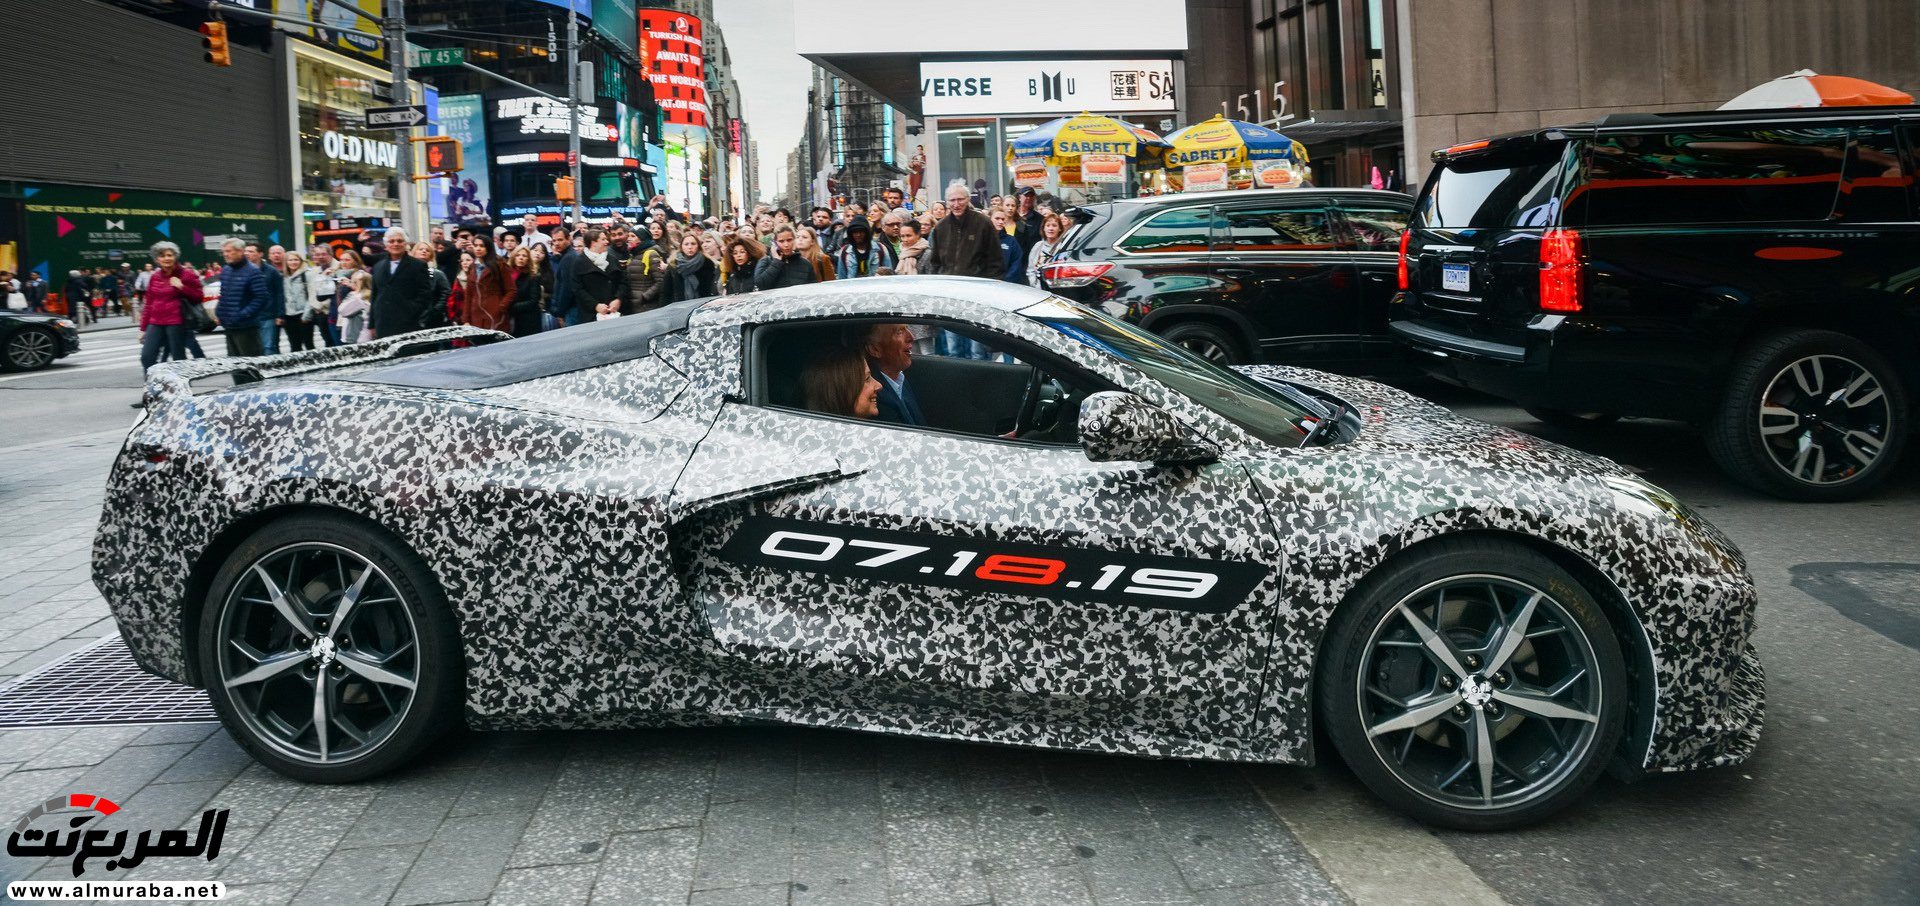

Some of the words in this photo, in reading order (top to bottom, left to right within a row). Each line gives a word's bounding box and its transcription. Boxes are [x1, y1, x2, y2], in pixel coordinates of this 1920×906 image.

[547, 22, 557, 62] 1500
[649, 31, 683, 41] TURKISH
[421, 51, 431, 64] W
[436, 50, 450, 63] 45
[656, 50, 689, 63] AWAITS
[649, 73, 667, 84] THE
[1029, 79, 1036, 96] B
[1067, 78, 1075, 95] U
[1221, 80, 1287, 123] 1515
[374, 113, 391, 123] ONE
[401, 111, 416, 121] WAY
[438, 105, 472, 118] BLESS
[323, 130, 362, 163] OLD
[363, 139, 398, 168] NAV
[1059, 141, 1132, 153] SABRETT
[1168, 147, 1238, 165] SABRETT
[759, 530, 1219, 599] 07.18.19
